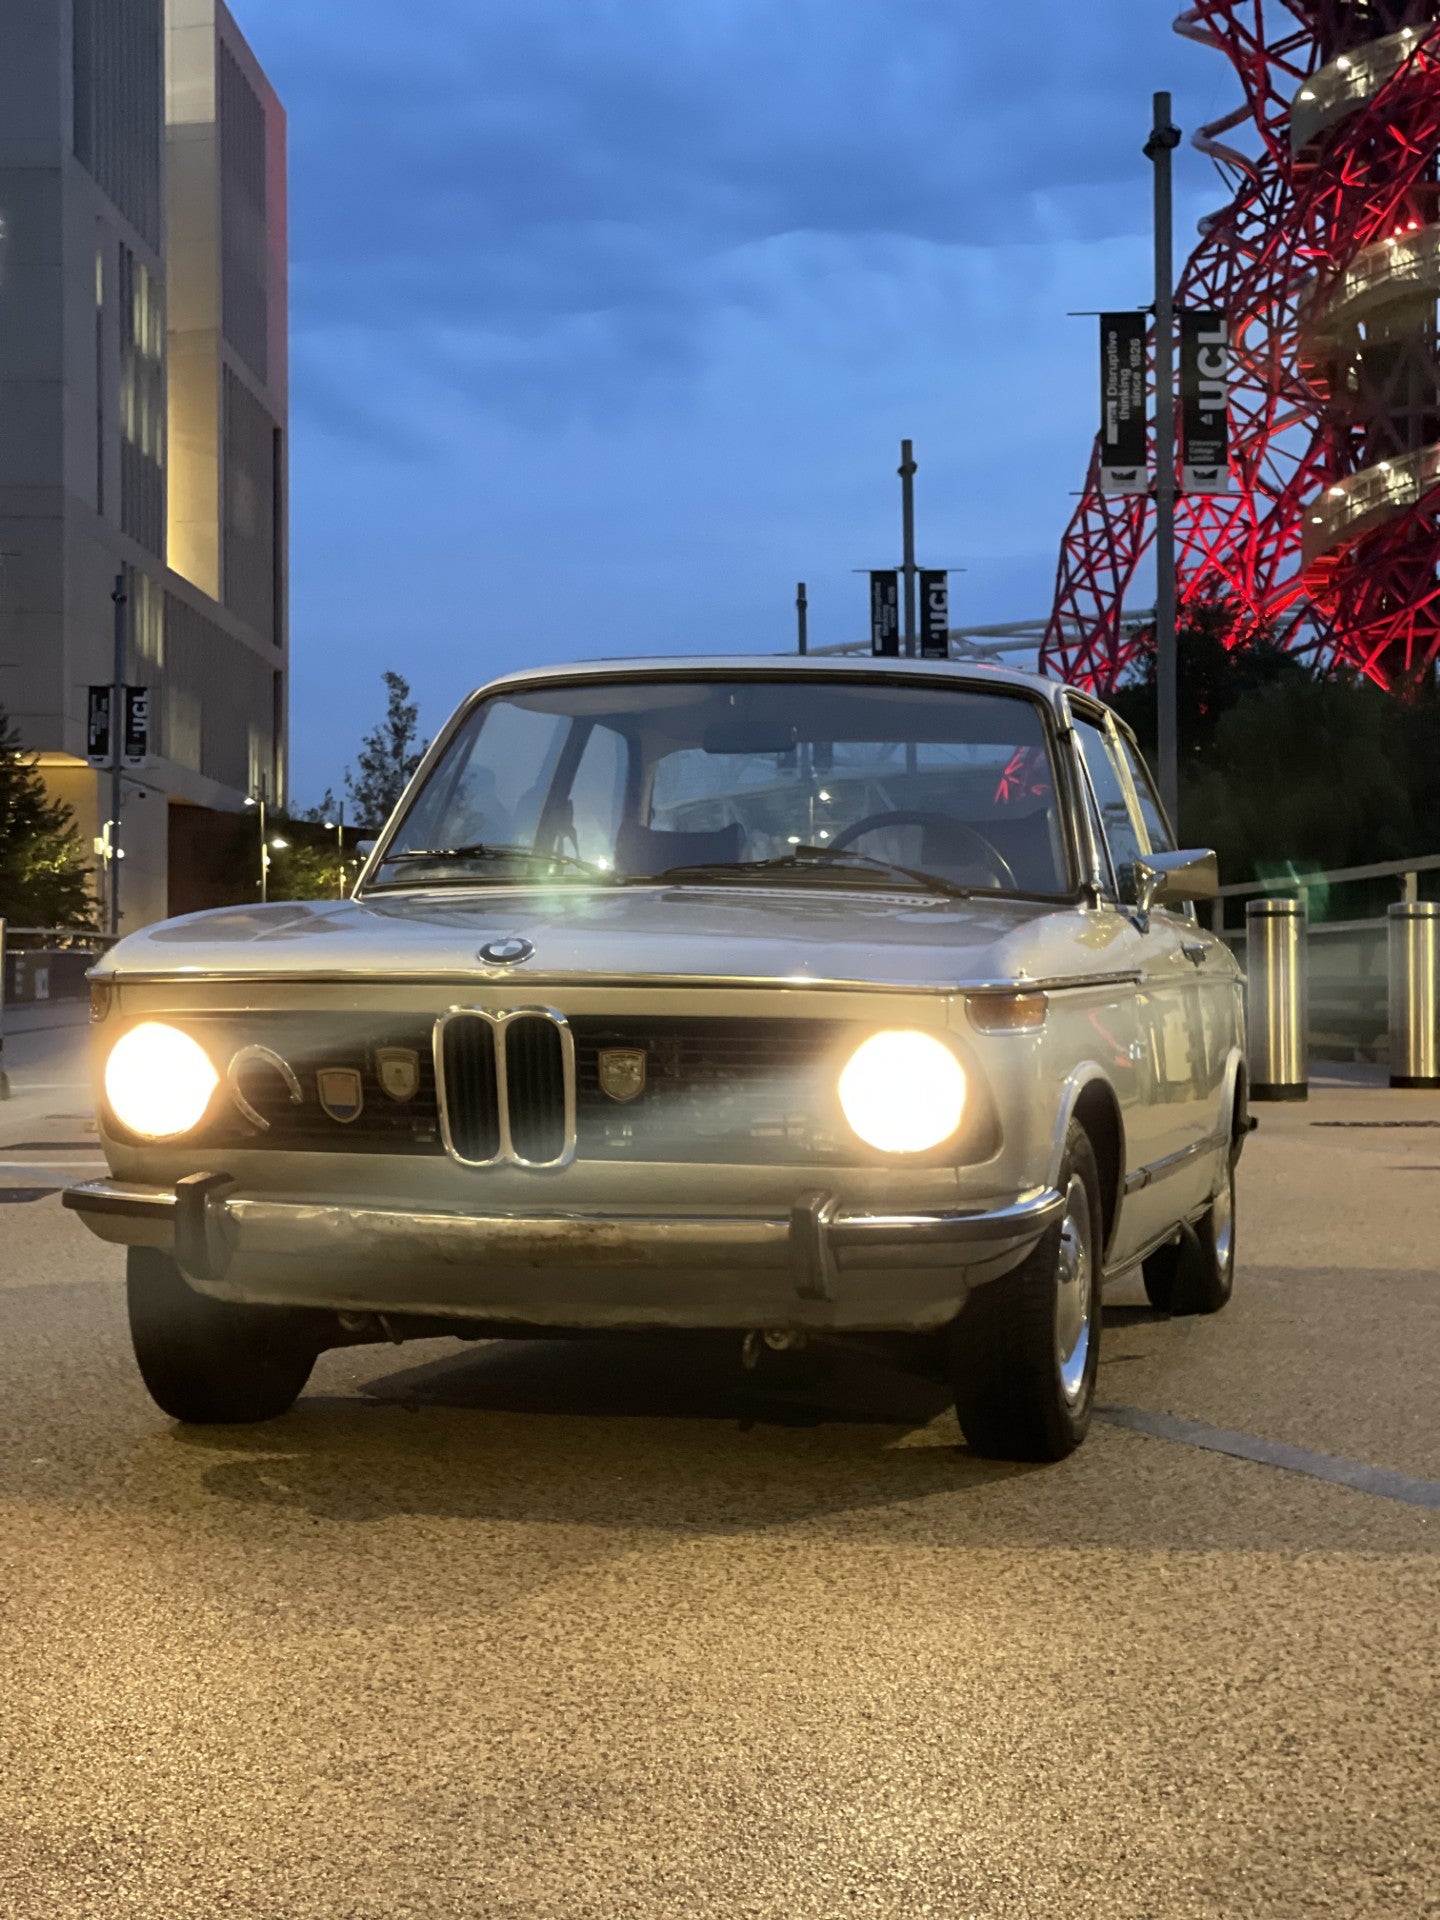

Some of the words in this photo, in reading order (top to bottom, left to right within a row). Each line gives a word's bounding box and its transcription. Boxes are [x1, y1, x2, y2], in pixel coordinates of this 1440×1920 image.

[1107, 331, 1119, 396] Disruptive
[1133, 371, 1141, 406] since
[1197, 320, 1228, 410] UCL
[1119, 368, 1131, 420] thinking
[929, 576, 948, 631] UCL
[132, 691, 150, 732] UCL
